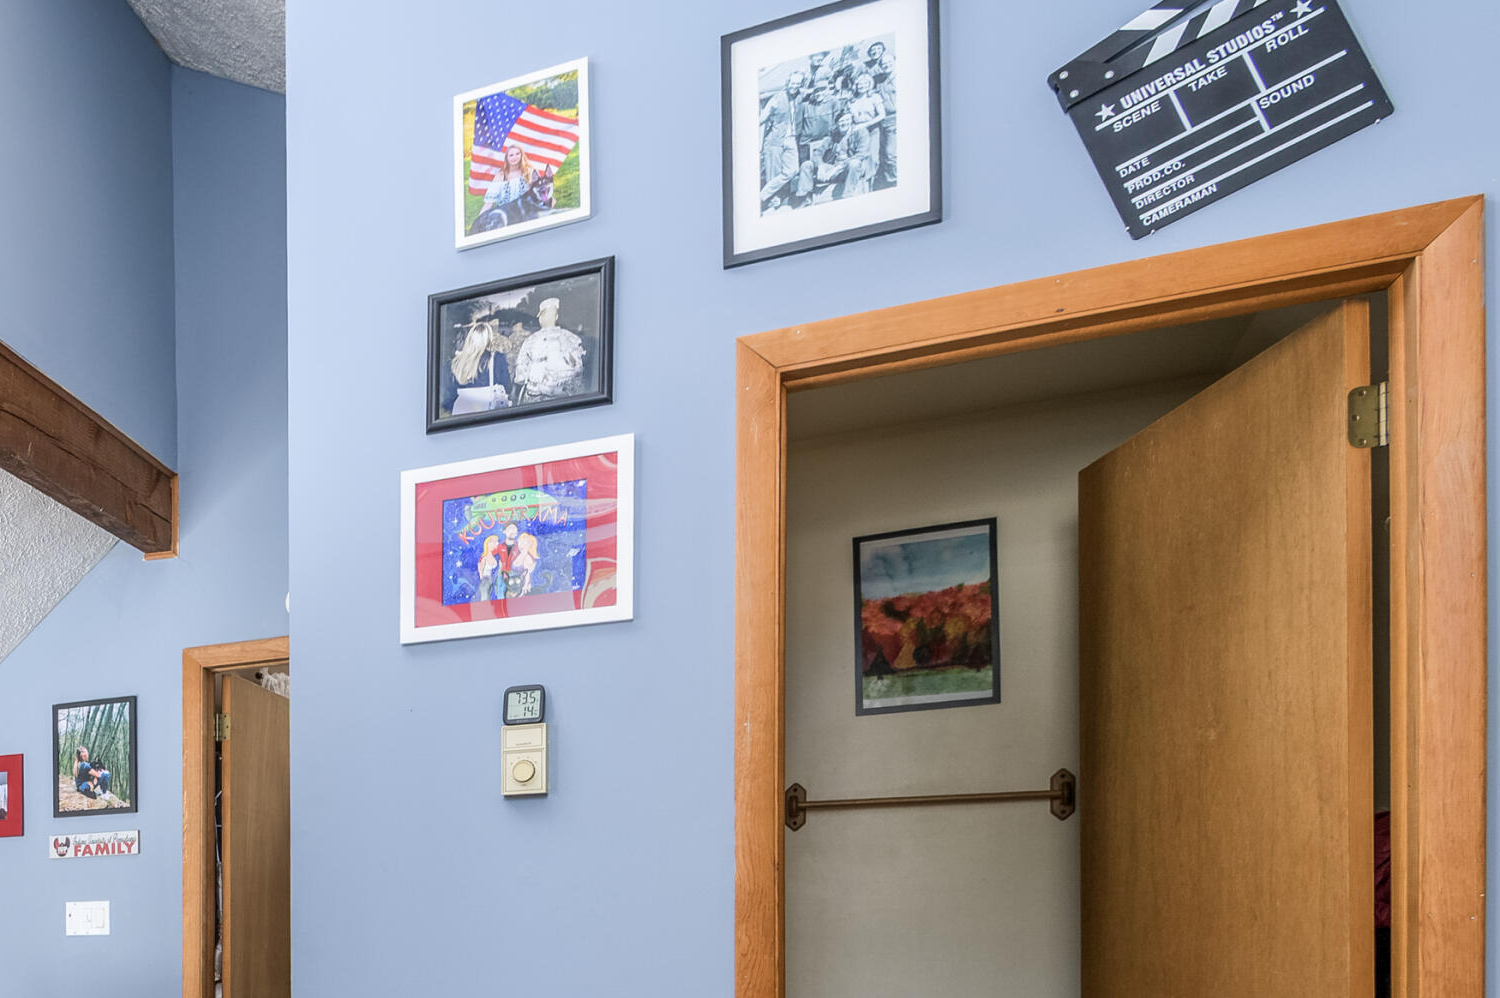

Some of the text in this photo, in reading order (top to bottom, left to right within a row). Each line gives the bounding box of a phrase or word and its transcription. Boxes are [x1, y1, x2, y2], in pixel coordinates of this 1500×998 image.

[1112, 24, 1310, 133] SCENE TAKE ROLL
[1119, 58, 1206, 110] UNIVERSAL
[1259, 73, 1316, 109] SOUND
[1119, 156, 1151, 178] DATE
[1126, 160, 1187, 195] PROD.CO.
[1135, 174, 1196, 210] DIRECTOR
[1142, 183, 1218, 226] CAMERAMAN
[73, 840, 135, 857] FAMILY
